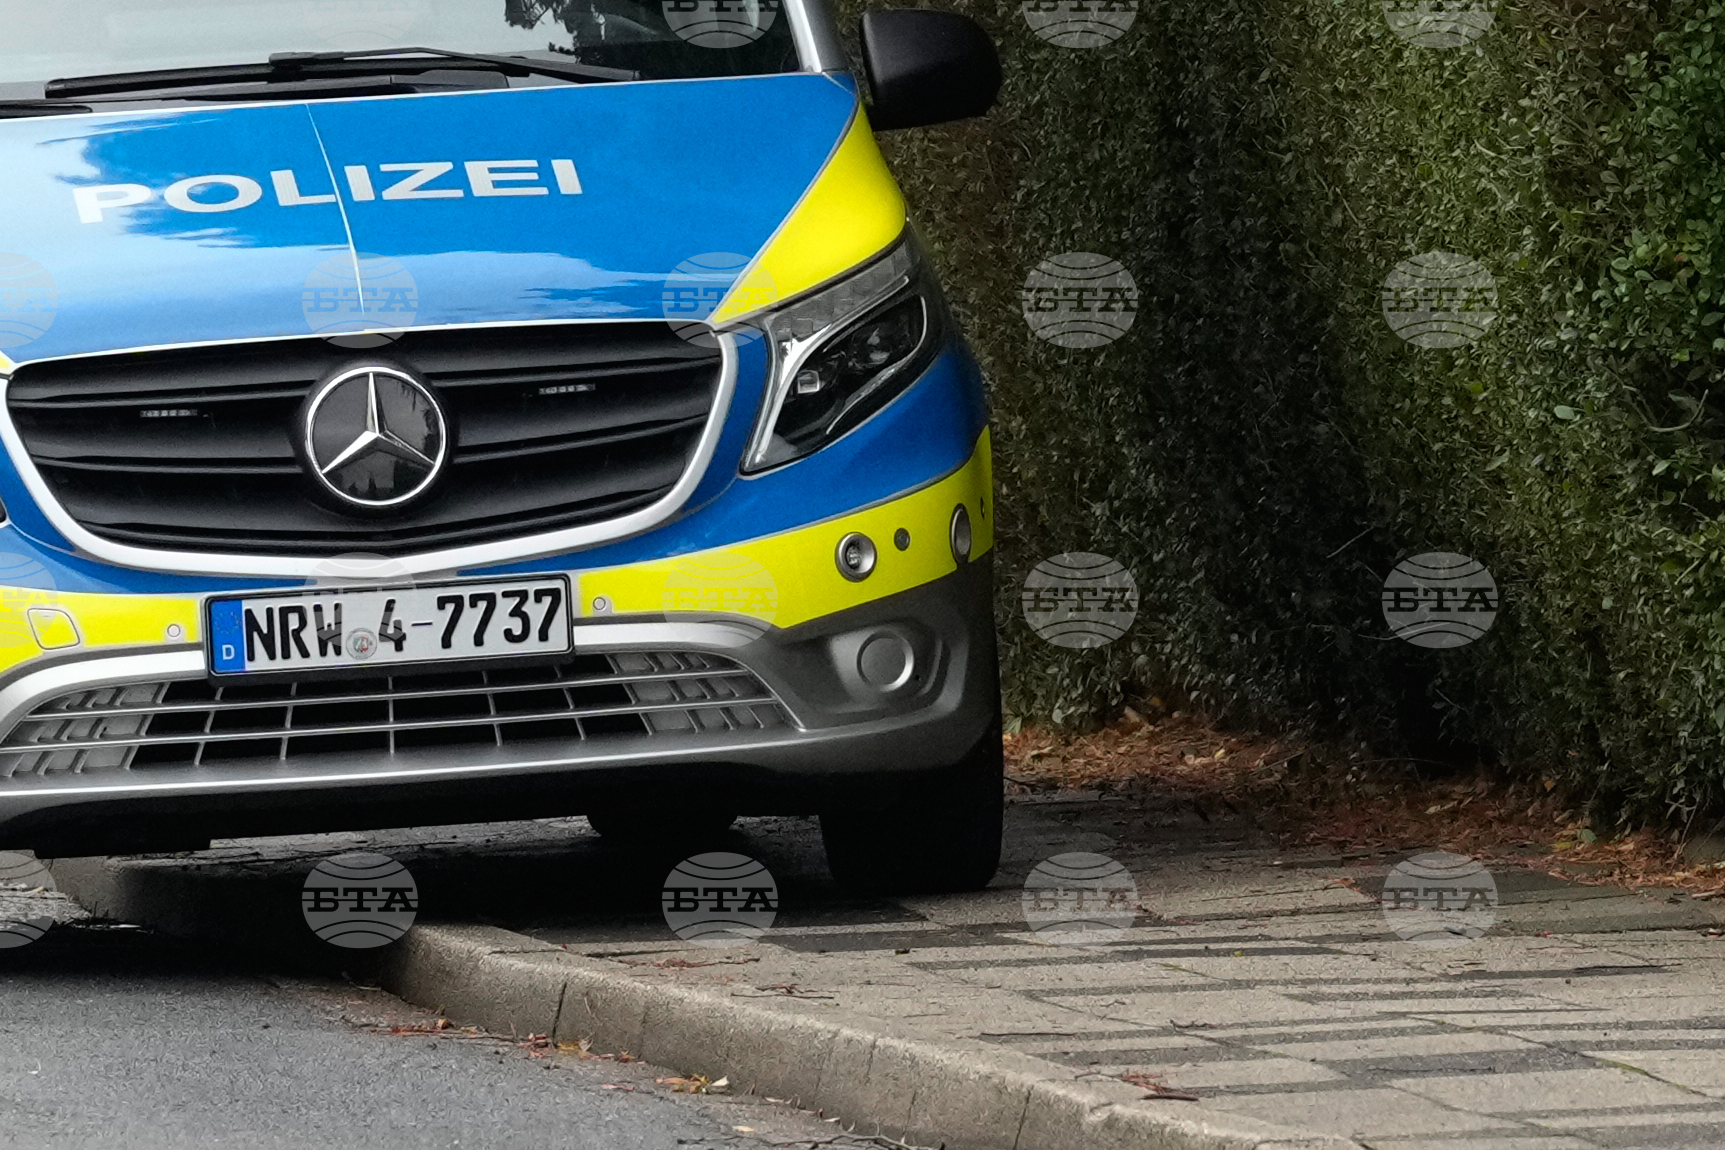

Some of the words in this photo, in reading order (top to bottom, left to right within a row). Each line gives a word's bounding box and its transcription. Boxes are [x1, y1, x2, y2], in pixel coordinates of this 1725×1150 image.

[73, 159, 583, 224] POLIZEI
[222, 644, 236, 661] D
[244, 602, 343, 662] NRW
[379, 588, 562, 652] 4-7737
